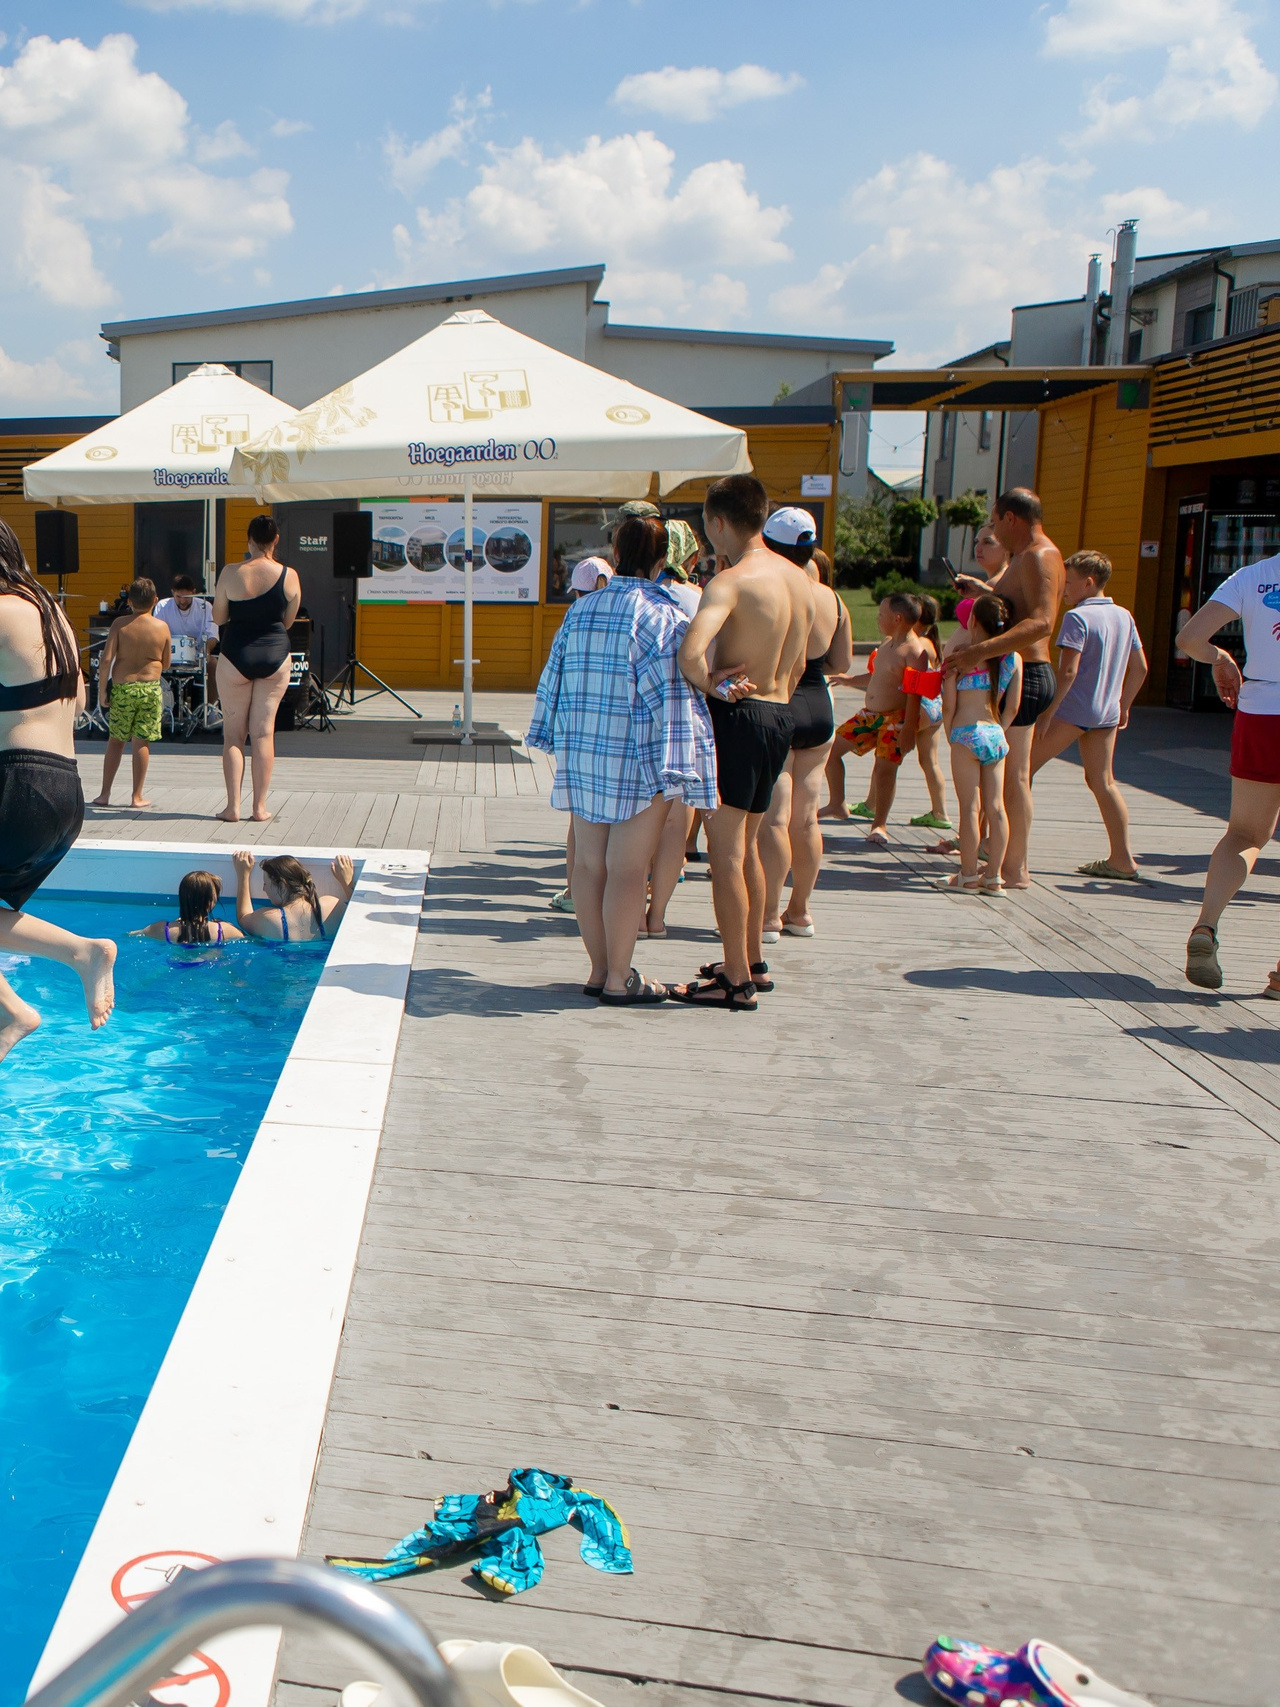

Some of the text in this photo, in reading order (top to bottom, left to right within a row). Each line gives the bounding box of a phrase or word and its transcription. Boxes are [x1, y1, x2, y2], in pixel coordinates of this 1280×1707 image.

[408, 438, 517, 467] Hoegaarden
[154, 467, 230, 489] Hoegaarde
[300, 536, 328, 545] Staff
